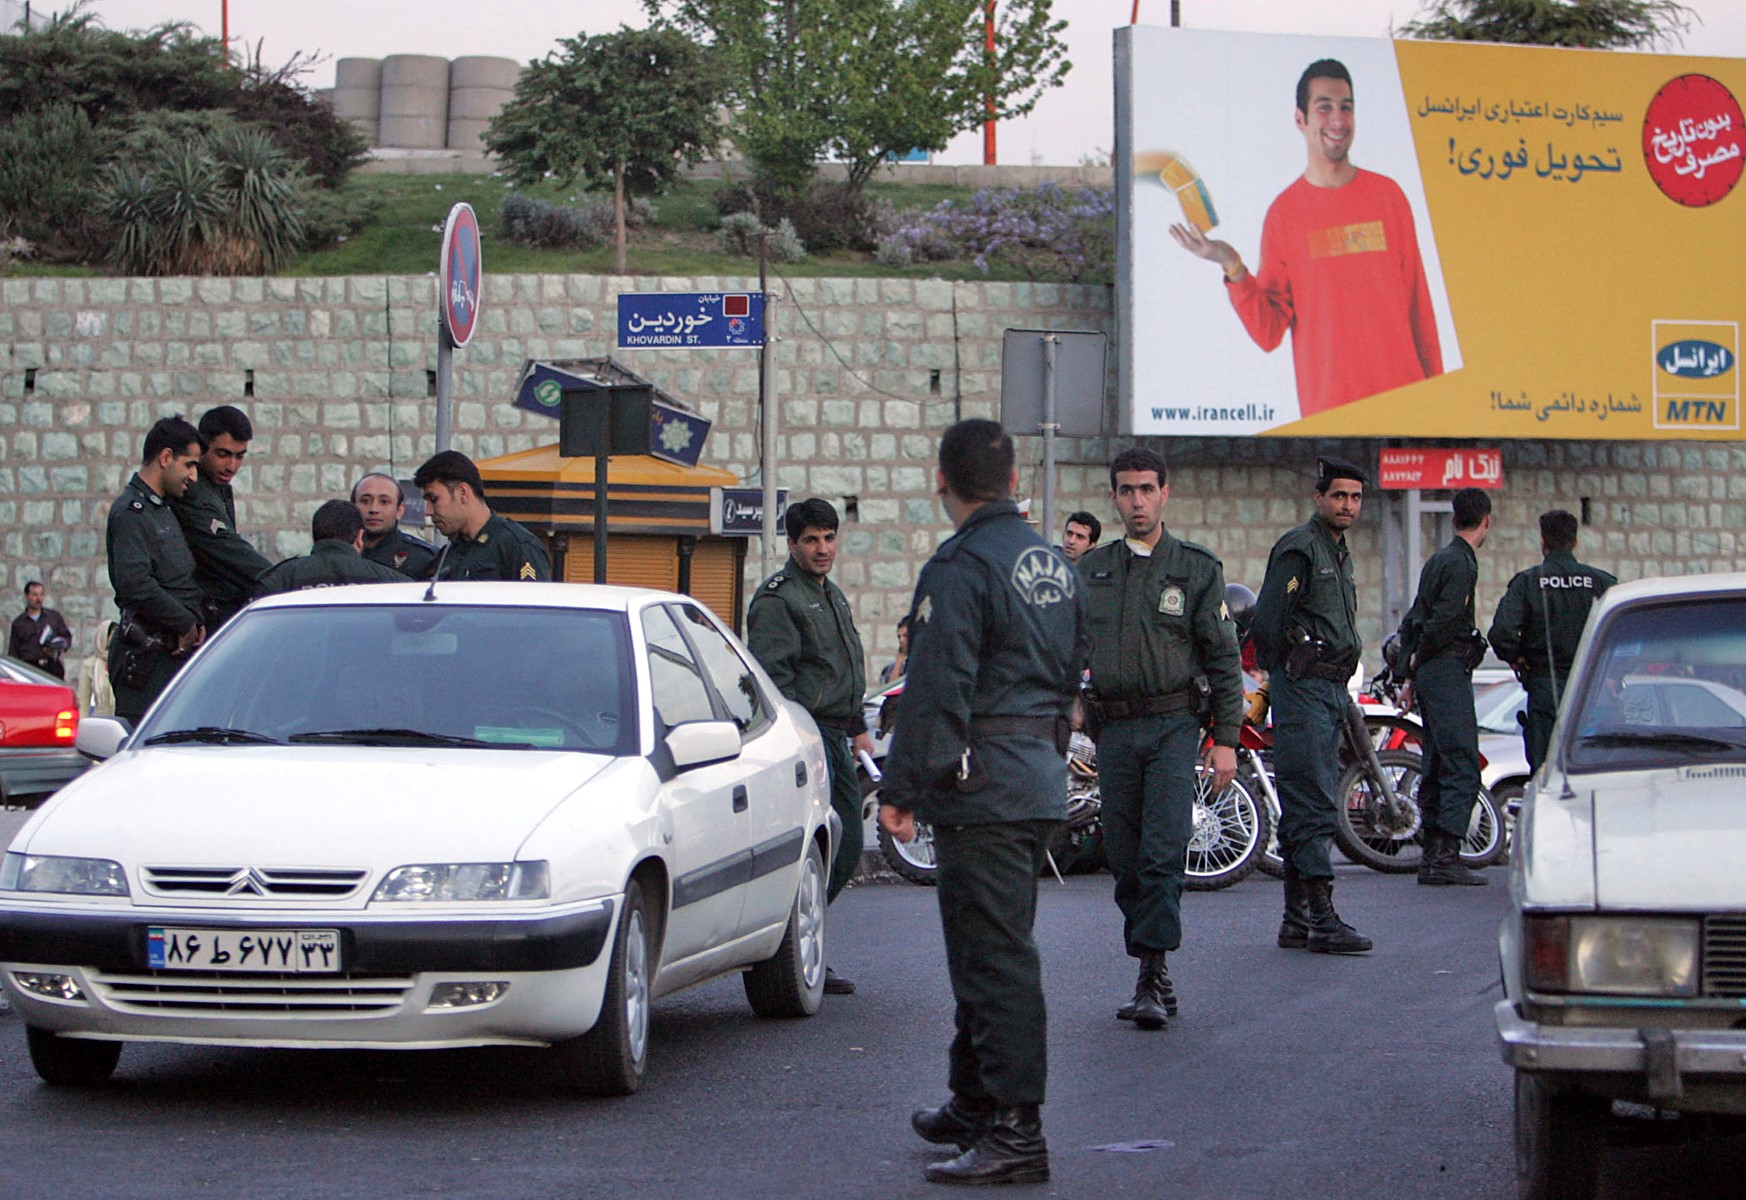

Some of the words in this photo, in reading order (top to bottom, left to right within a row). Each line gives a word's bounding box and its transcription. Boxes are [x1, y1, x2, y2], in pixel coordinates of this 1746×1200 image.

[1418, 96, 1481, 122] ایرانسل
[1485, 100, 1549, 123] اعتباری
[1696, 113, 1731, 140] بدون
[1651, 118, 1697, 164] تاریخ
[1448, 137, 1529, 180] فوری!
[1536, 143, 1622, 183] تحویل
[1674, 142, 1740, 179] مصرف
[698, 294, 721, 304] خیابان
[628, 306, 714, 334] خوردین
[627, 335, 682, 345] KHOVARDIN
[686, 335, 702, 345] ST.
[1665, 345, 1727, 376] ایرانسل
[1151, 403, 1275, 421] www.irancell.ir
[1589, 393, 1642, 421] شماره
[1666, 401, 1727, 422] MTN
[1442, 453, 1463, 486] نام
[1469, 453, 1500, 484] نیک
[1017, 553, 1067, 589] NAJA
[1539, 575, 1593, 589] POLICE
[301, 942, 335, 968] ۳۳
